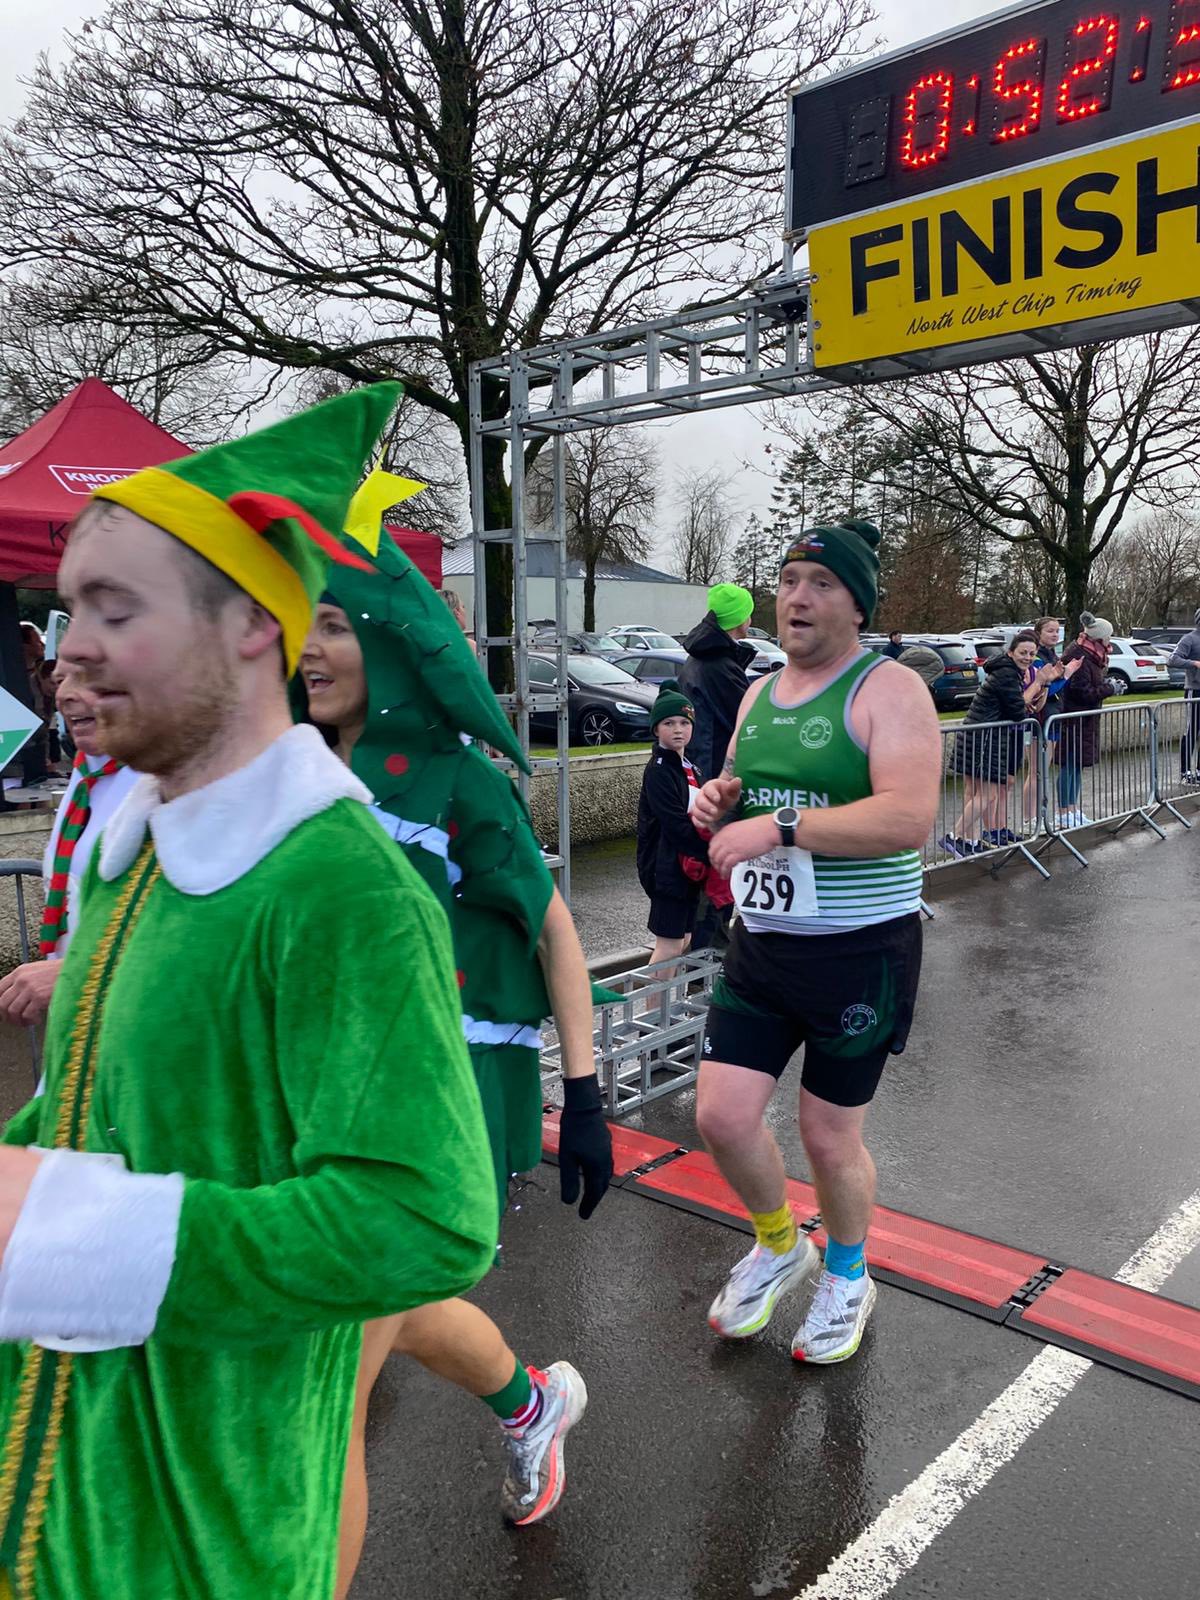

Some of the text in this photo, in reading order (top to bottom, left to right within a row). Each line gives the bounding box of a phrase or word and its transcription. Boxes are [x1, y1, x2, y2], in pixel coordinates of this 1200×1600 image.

[849, 144, 1200, 316] FINISH
[906, 275, 1143, 336] North West Chip Timing
[63, 471, 129, 483] KNOC
[741, 787, 829, 808] ARMEN
[741, 869, 795, 912] 259
